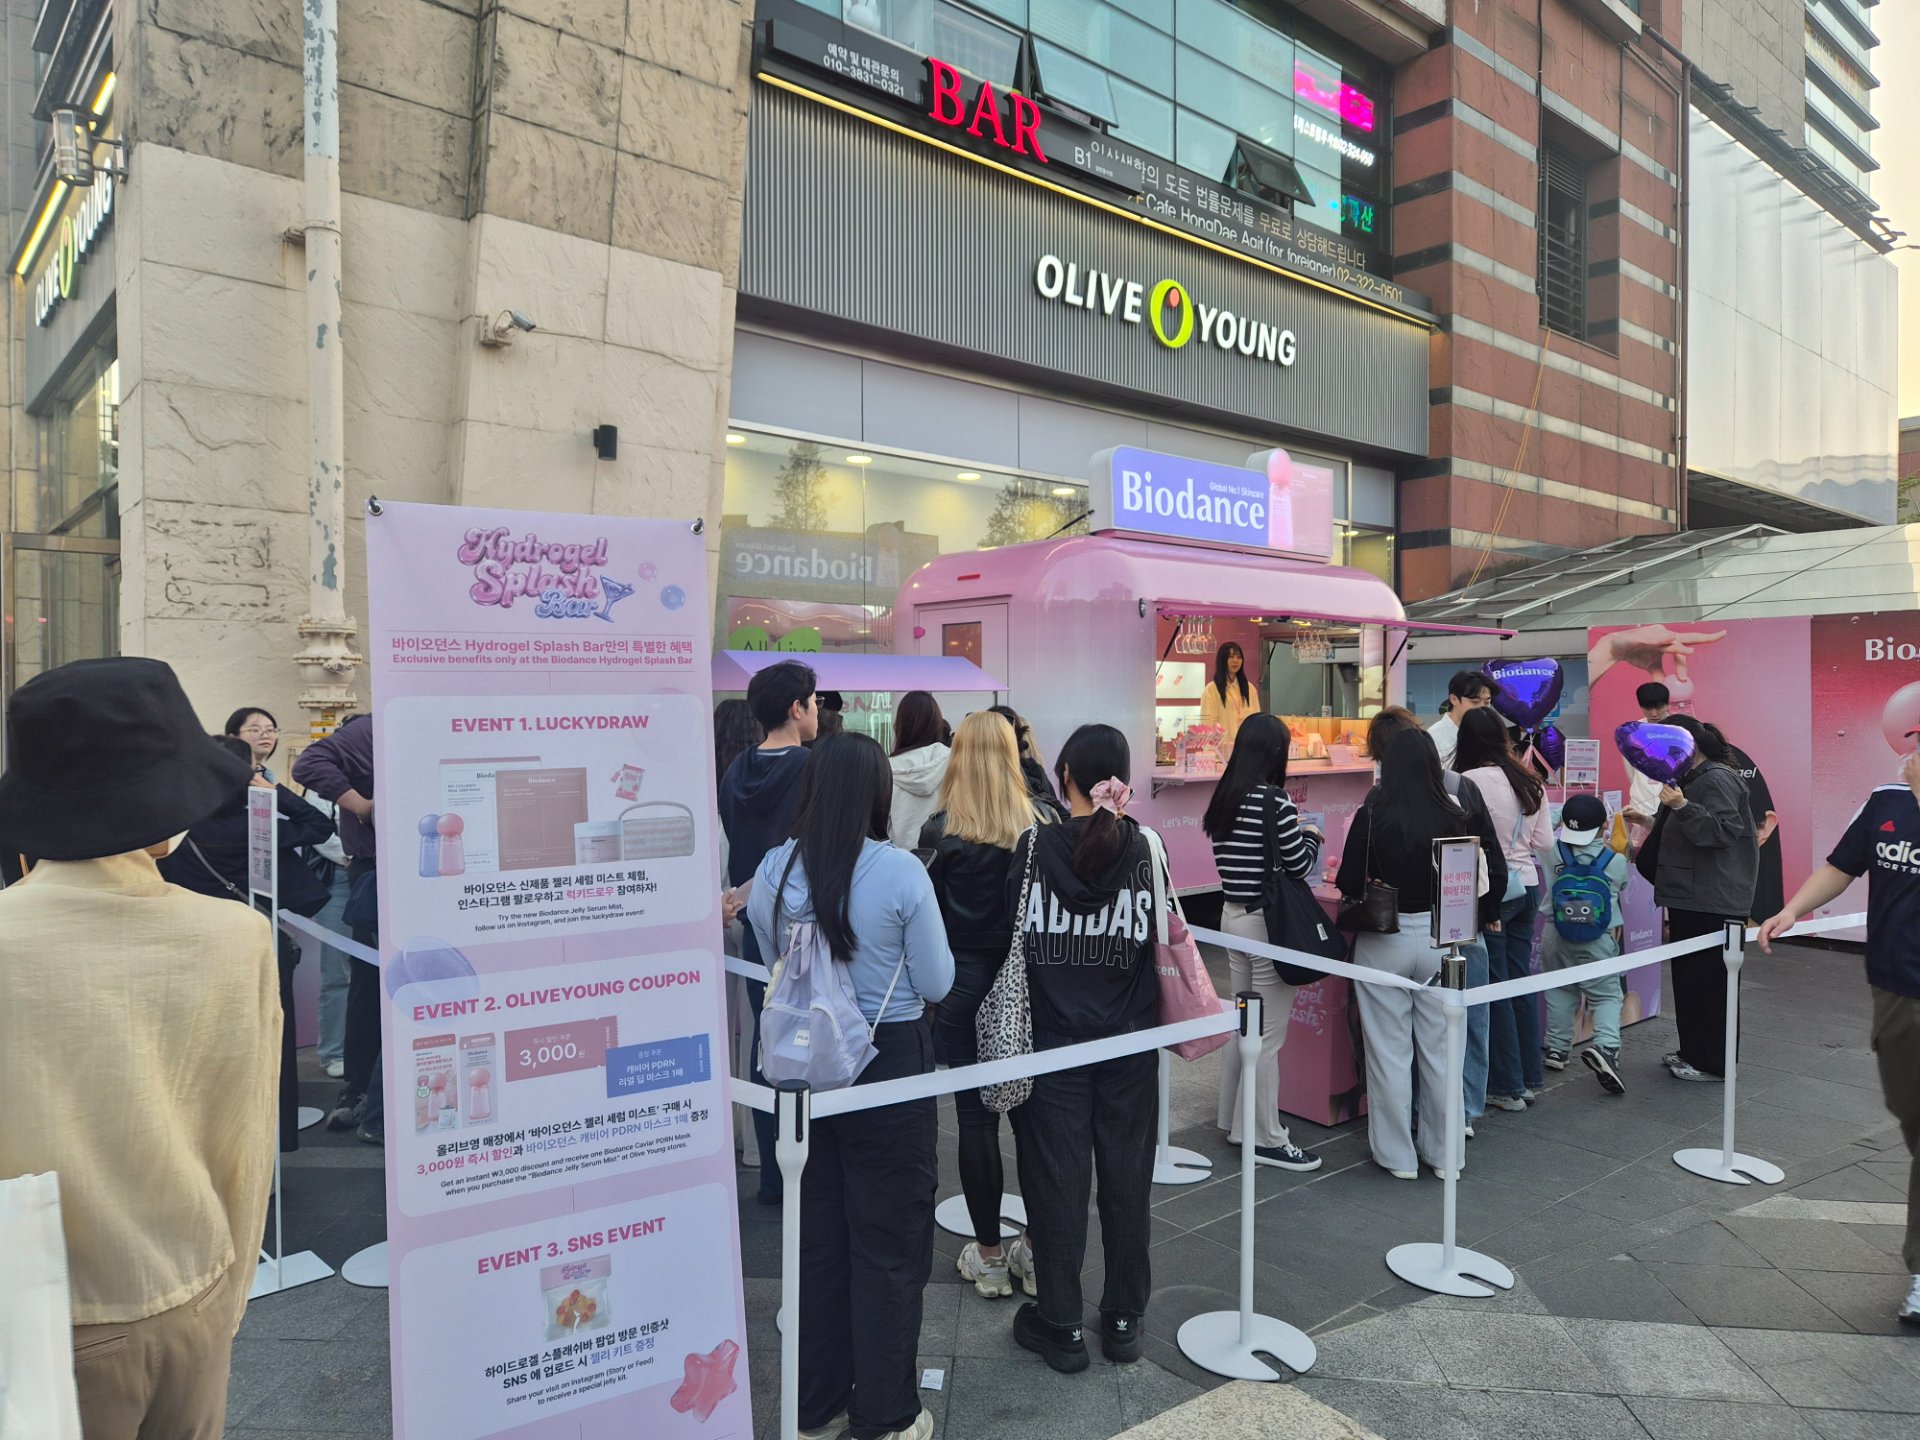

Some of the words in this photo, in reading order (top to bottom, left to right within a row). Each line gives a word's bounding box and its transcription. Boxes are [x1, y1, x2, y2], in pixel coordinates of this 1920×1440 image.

[823, 55, 904, 97] 010-3831-0321
[828, 43, 848, 62] 예약
[861, 57, 899, 83] 대관문의
[927, 56, 1048, 163] BAR
[1074, 146, 1091, 169] B1
[35, 251, 59, 327] OLIVE
[73, 156, 112, 262] YOUNG
[1146, 193, 1177, 218] Cafe
[1265, 237, 1284, 258] (for
[1165, 173, 1190, 202] 모든
[1196, 185, 1254, 227] 법률문제를
[1259, 212, 1292, 241] 무료로
[1296, 227, 1366, 271] 상담해드립니다
[1036, 254, 1143, 323] OLIVE
[1198, 303, 1296, 367] YOUNG
[1122, 470, 1265, 530] Biodance
[457, 526, 608, 573] Hydrogel
[469, 559, 599, 608] Splash
[535, 589, 599, 619] Bar
[392, 637, 461, 651] 바이오던스
[465, 640, 530, 654] Hydrogel
[533, 640, 579, 654] Splash
[583, 640, 629, 654] Bar만의
[632, 640, 667, 654] 특별한
[670, 641, 693, 654] 혜택
[393, 654, 445, 664] Exclusive
[448, 654, 492, 664] benefits
[495, 655, 516, 665] only
[520, 656, 529, 664] at
[532, 655, 548, 664] the
[551, 655, 597, 664] Biodance
[599, 655, 642, 666] Hydrogel
[644, 656, 676, 666] Splash
[677, 656, 693, 665] Bar
[1865, 636, 1920, 661] Bio
[1492, 665, 1555, 680] Biodance
[451, 717, 515, 732] EVENT
[519, 717, 533, 732] 1.
[535, 715, 650, 730] LUCKYDRAW
[1182, 815, 1199, 828] Play
[458, 894, 511, 910] 인스타그램
[513, 891, 564, 906] 팔로우하고
[566, 886, 615, 900] 럭키드로우
[616, 882, 658, 896] 참여하자!
[464, 881, 517, 895] 바이오던스
[519, 878, 549, 891] 신제품
[552, 876, 572, 888] 젤리
[574, 874, 594, 886] 세럼
[596, 872, 626, 884] 미스트
[627, 869, 649, 882] 체험,
[1459, 884, 1472, 896] 라인
[498, 914, 509, 922] Try
[539, 908, 570, 917] Biodance
[570, 905, 586, 915] Jelly
[586, 904, 608, 912] Serum
[1023, 882, 1152, 942] ADIDAS
[413, 998, 480, 1021] EVENT
[484, 997, 501, 1012] 2.
[505, 980, 625, 1009] OLIVEYOUNG
[628, 970, 701, 992] COUPON
[519, 1042, 577, 1070] 3,000
[618, 1075, 635, 1087] 리얼
[636, 1074, 645, 1084] 딥
[646, 1070, 670, 1082] 마스크
[672, 1067, 684, 1078] 1매
[626, 1062, 650, 1074] 캐비어
[651, 1058, 676, 1070] PDRN
[417, 1156, 465, 1176] 3,000원
[468, 1151, 489, 1166] 즉시
[492, 1145, 524, 1161] 할인과
[526, 1134, 577, 1154] 바이오던스
[580, 1128, 609, 1143] 캐비어
[611, 1123, 641, 1137] PDRN
[643, 1116, 672, 1131] 마스크
[674, 1112, 689, 1125] 1매
[690, 1108, 709, 1122] 증정
[436, 1138, 480, 1157] 올리브영
[483, 1130, 525, 1147] 매장에서
[584, 1115, 604, 1129] 젤리
[606, 1110, 626, 1124] 세럼
[662, 1101, 681, 1114] 구매
[683, 1098, 692, 1109] 시
[440, 1179, 455, 1189] Get
[455, 1178, 465, 1186] an
[465, 1173, 490, 1184] instant
[520, 1160, 550, 1173] discount
[551, 1158, 564, 1168] and
[565, 1153, 590, 1164] receive
[590, 1150, 603, 1158] one
[604, 1145, 634, 1156] Biodance
[634, 1140, 655, 1150] Caviar
[655, 1136, 674, 1145] PDRN
[674, 1132, 691, 1141] Mask
[478, 1245, 542, 1274] EVENT
[546, 1242, 564, 1258] 3.
[567, 1231, 604, 1252] SNS
[607, 1217, 666, 1243] EVENT
[485, 1353, 539, 1378] 하이드로겔
[541, 1339, 593, 1363] 스플래쉬바
[595, 1332, 616, 1349] 팝업
[618, 1327, 638, 1342] 방문
[640, 1318, 669, 1336] 인증샷
[503, 1373, 528, 1389] SNS
[530, 1368, 541, 1381] 에
[543, 1359, 576, 1378] 업로드
[577, 1355, 588, 1367] 시
[590, 1349, 611, 1365] 젤리
[613, 1343, 633, 1357] 키트
[635, 1337, 655, 1352] 증정
[506, 1394, 527, 1405] Share
[528, 1389, 544, 1400] your
[545, 1384, 560, 1394] visit
[561, 1381, 570, 1389] on
[570, 1372, 605, 1385] Instagram
[606, 1365, 626, 1377] (Story
[635, 1356, 654, 1367] Feed)
